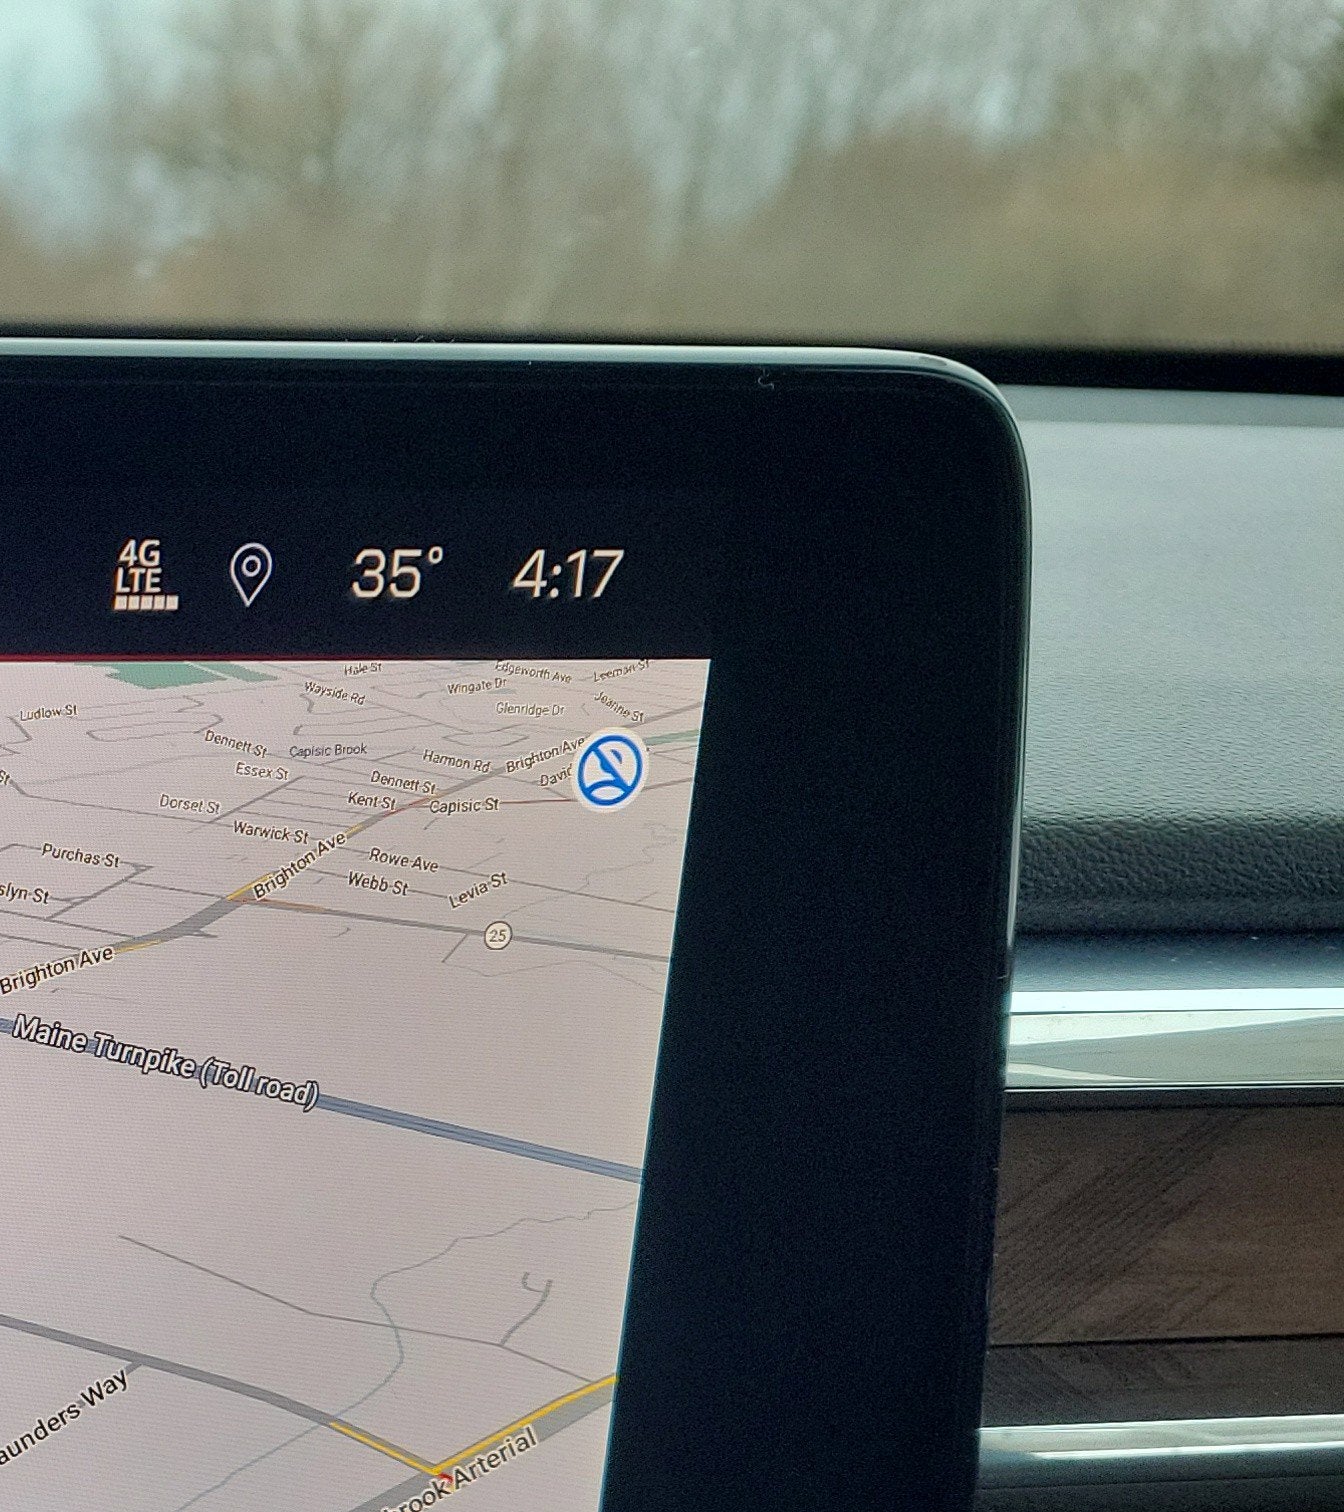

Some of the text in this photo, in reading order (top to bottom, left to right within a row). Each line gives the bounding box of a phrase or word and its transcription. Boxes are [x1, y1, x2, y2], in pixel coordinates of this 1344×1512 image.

[121, 540, 160, 566] 4G
[116, 567, 161, 593] LTE
[352, 546, 443, 598] 35°
[512, 549, 624, 598] 4:17
[305, 681, 348, 700] Wayside
[447, 677, 507, 695] Wingate Dr
[20, 705, 78, 721] Ludlow St
[496, 702, 564, 718] Glenridge Dr
[205, 730, 267, 758] Dennett St
[289, 744, 367, 758] Capisic Brook
[506, 737, 585, 774] Brighton Ave
[236, 762, 288, 780] Essex St
[473, 760, 492, 773] Rd
[371, 772, 435, 794] Dennett St
[160, 794, 220, 814] Dorset St
[348, 793, 396, 810] Kent St
[430, 798, 499, 815] Capisic St
[233, 821, 308, 844] Warwick St
[42, 843, 119, 868] Purchas St
[253, 833, 346, 899] Brighton Ave
[369, 848, 439, 873] Rowe Ave
[347, 871, 409, 896] Webb St
[449, 872, 508, 908] Levia St
[32, 889, 49, 904] St
[489, 930, 507, 943] 25
[0, 947, 113, 995] Brighton Ave
[12, 1014, 320, 1112] Maine Turnpike (Toll road)
[80, 1366, 130, 1408] Way
[450, 1425, 537, 1490] Arterial
